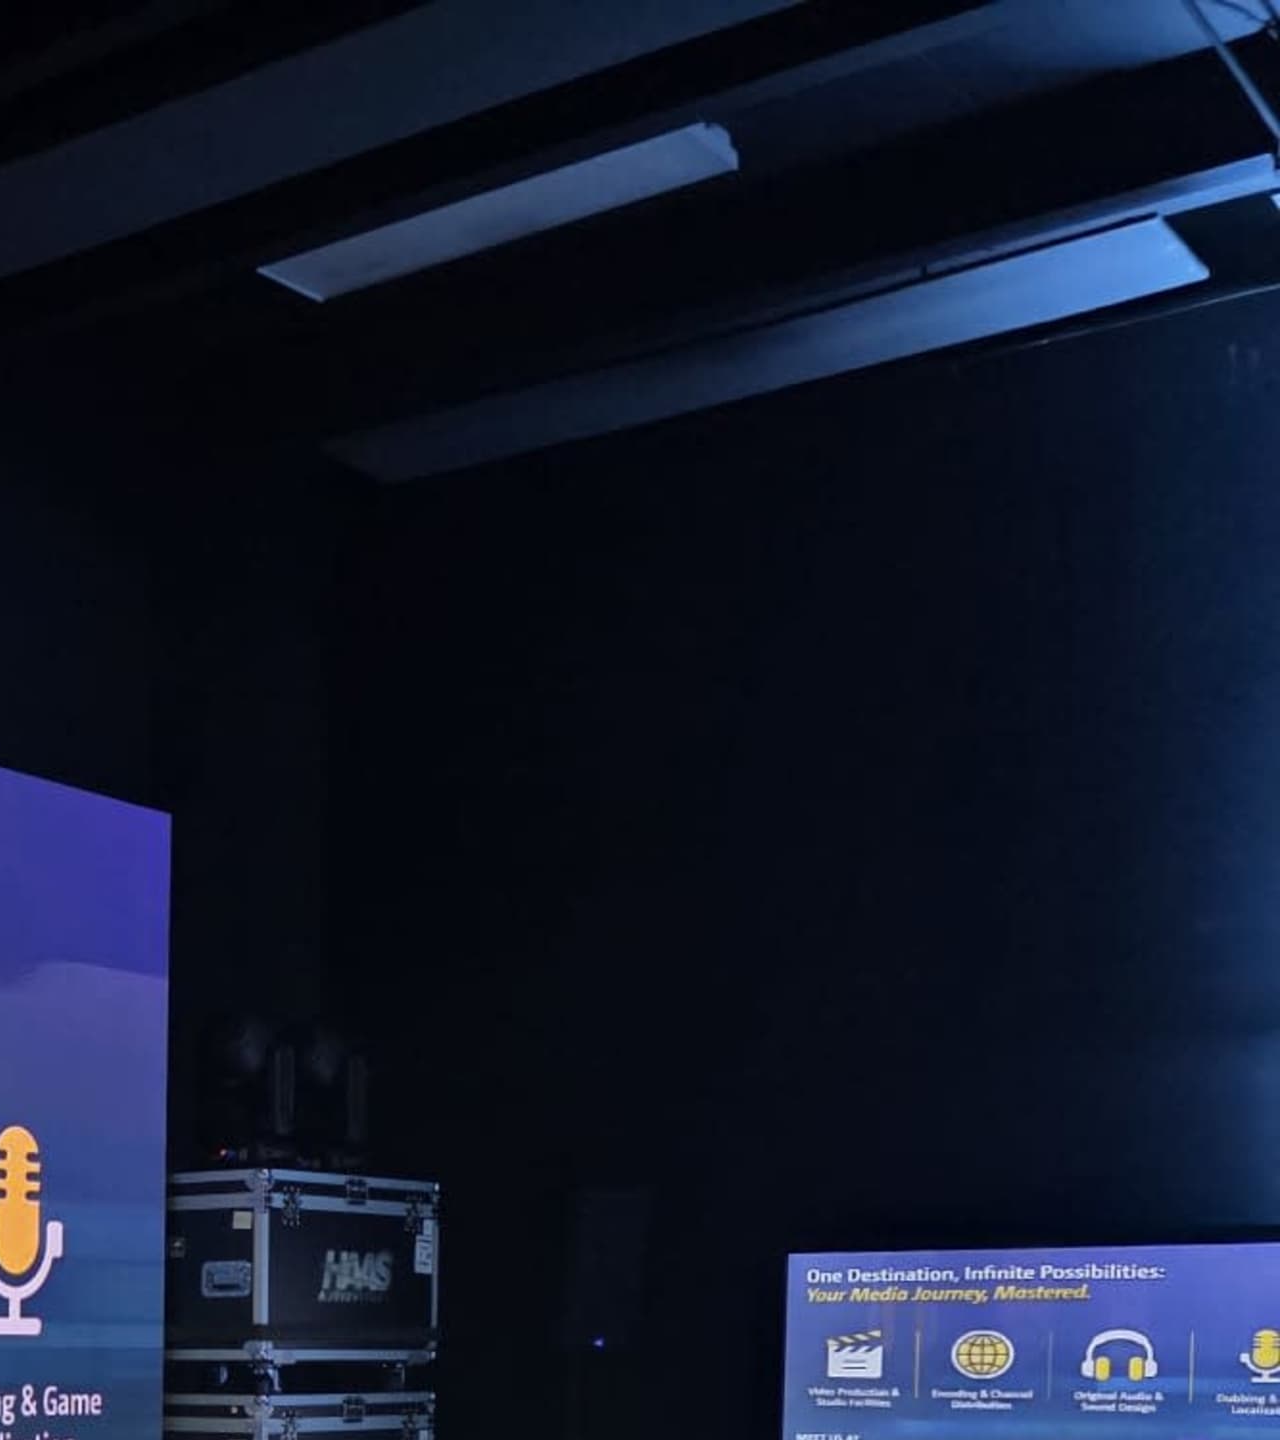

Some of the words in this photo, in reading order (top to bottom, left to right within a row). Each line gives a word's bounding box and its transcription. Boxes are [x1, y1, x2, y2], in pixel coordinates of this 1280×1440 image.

[322, 1250, 392, 1290] HAAS
[807, 1269, 842, 1283] One
[847, 1267, 959, 1283] Destination,
[964, 1265, 1034, 1280] Infinite
[1040, 1264, 1166, 1280] Possibilities:
[807, 1287, 846, 1302] Your
[849, 1286, 908, 1302] Media
[911, 1286, 988, 1304] Journey,
[993, 1284, 1091, 1300] Mastered.
[20, 1385, 38, 1417] &
[43, 1386, 103, 1417] Game
